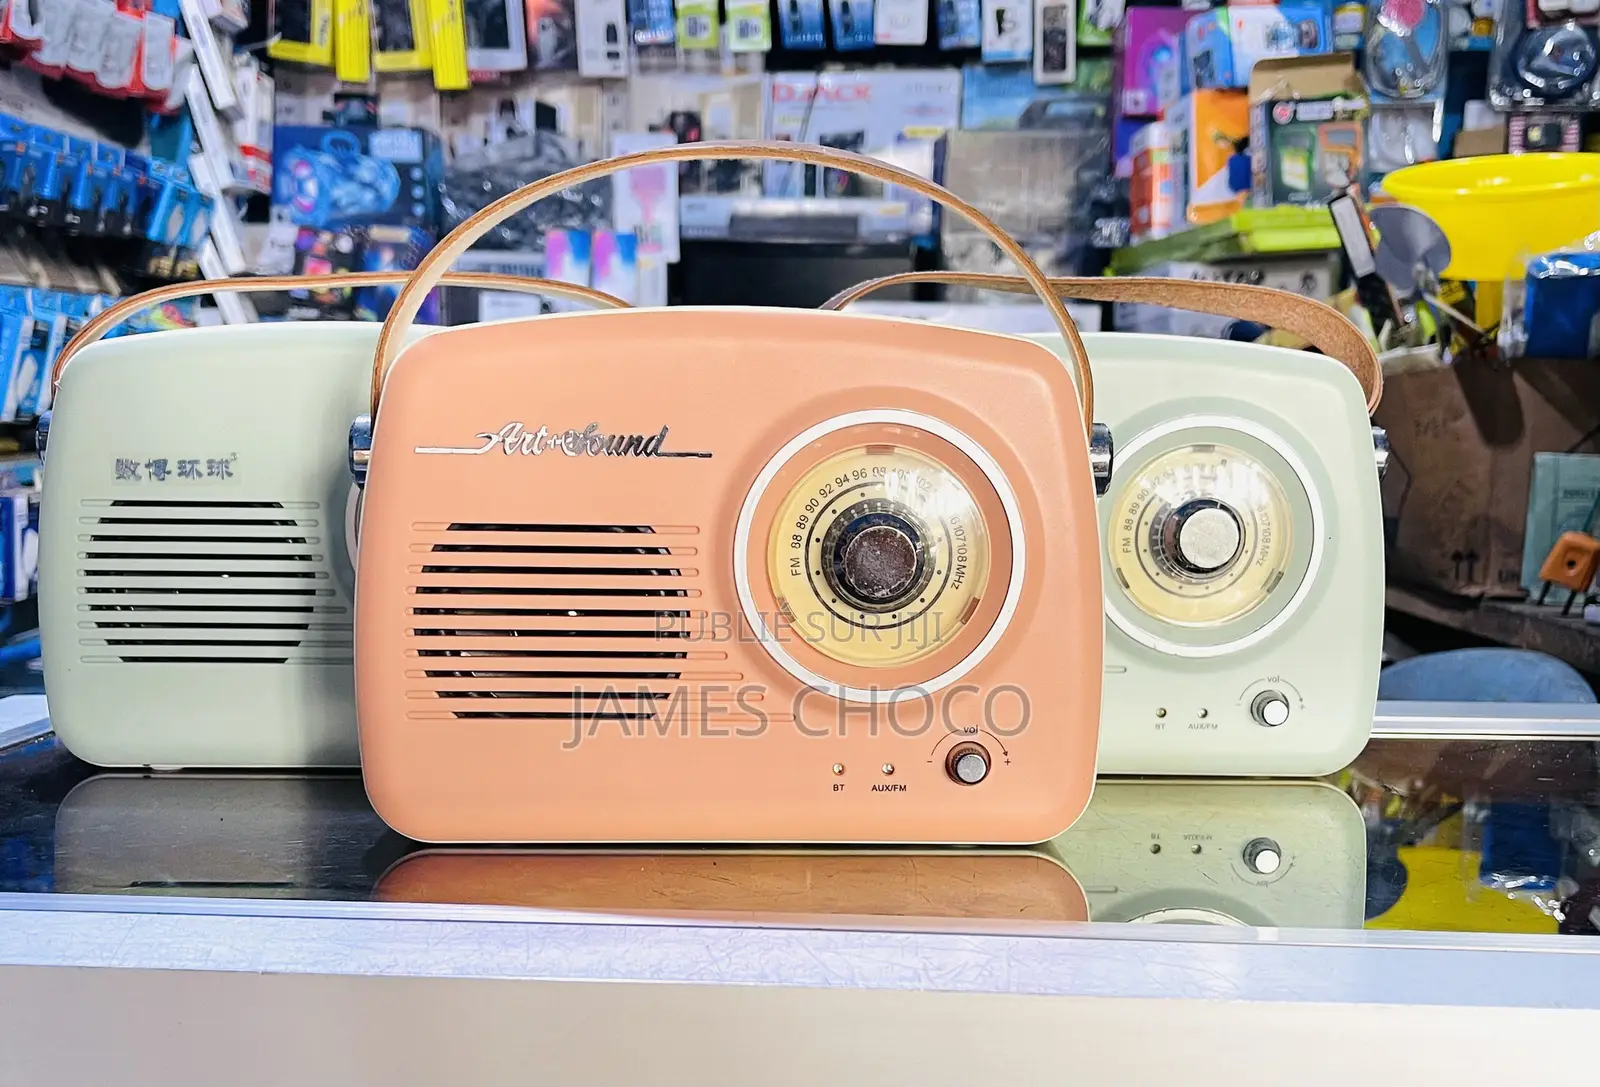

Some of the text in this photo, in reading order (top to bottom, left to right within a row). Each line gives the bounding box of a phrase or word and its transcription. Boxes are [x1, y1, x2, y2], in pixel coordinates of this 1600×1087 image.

[835, 473, 850, 488] 94
[852, 467, 868, 480] 96
[819, 483, 835, 499] 92
[1136, 488, 1149, 502] 90
[805, 497, 820, 514] 90
[1128, 502, 1141, 516] 89
[796, 514, 809, 530] 89
[1123, 518, 1134, 532] 88
[791, 534, 803, 549] 88
[1122, 537, 1132, 554] FM
[790, 557, 801, 577] FM
[1267, 675, 1280, 683] vol
[832, 784, 845, 792] BT
[871, 784, 907, 792] AUX/FM
